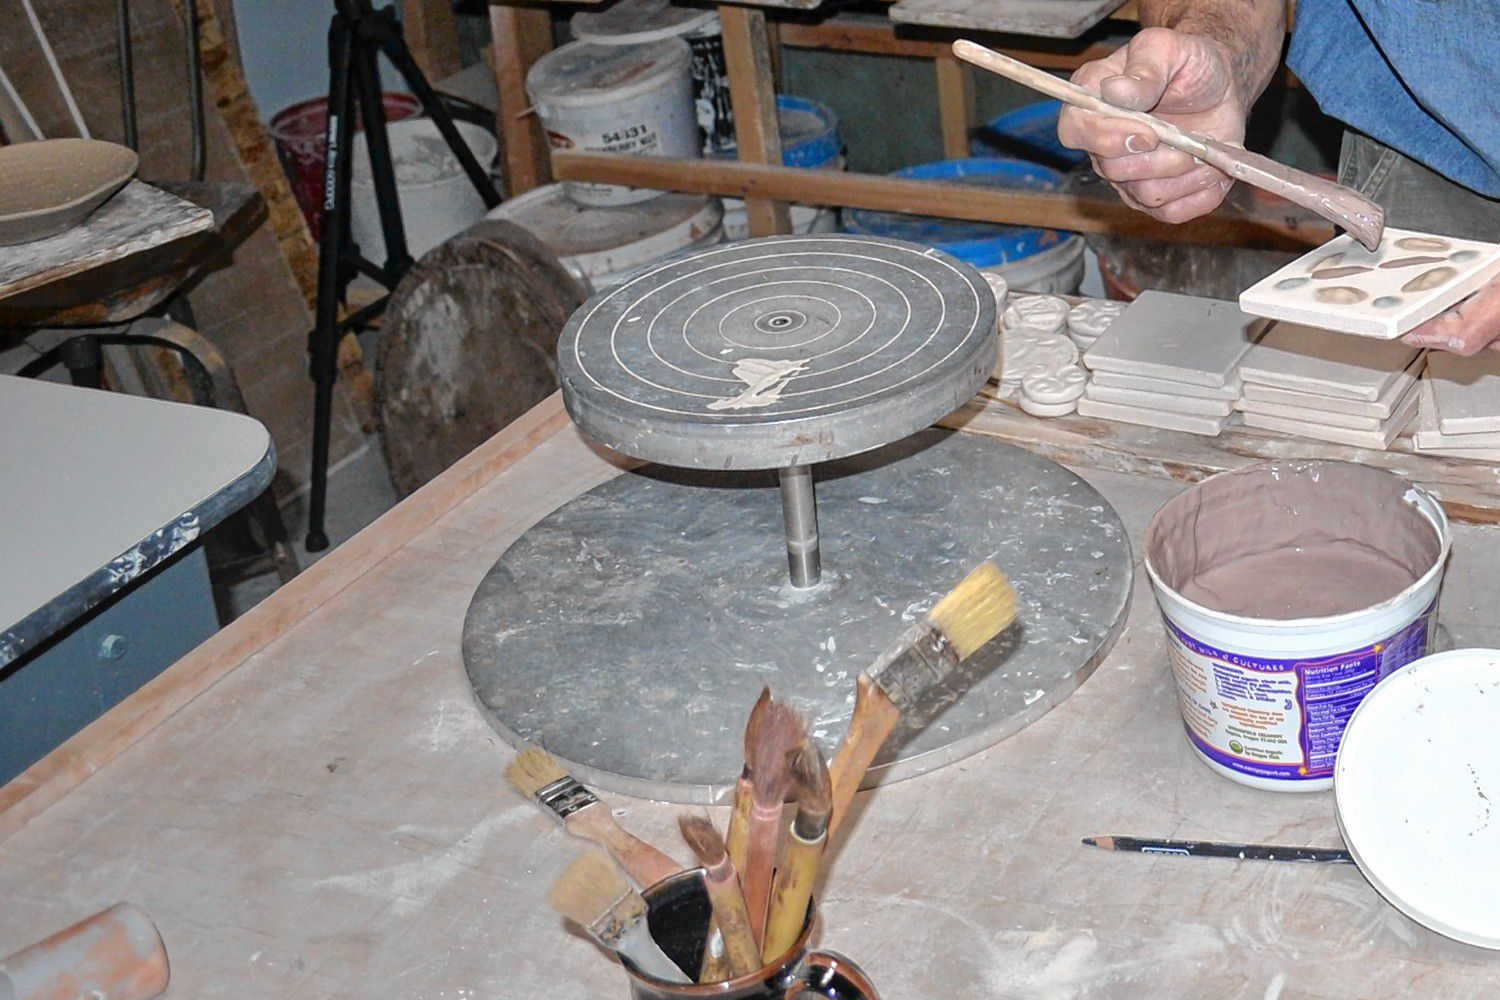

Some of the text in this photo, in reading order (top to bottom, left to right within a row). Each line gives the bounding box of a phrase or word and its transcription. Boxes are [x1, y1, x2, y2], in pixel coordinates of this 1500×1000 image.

[1232, 656, 1286, 672] CULTURES
[1304, 660, 1361, 676] Nutrition Facts
